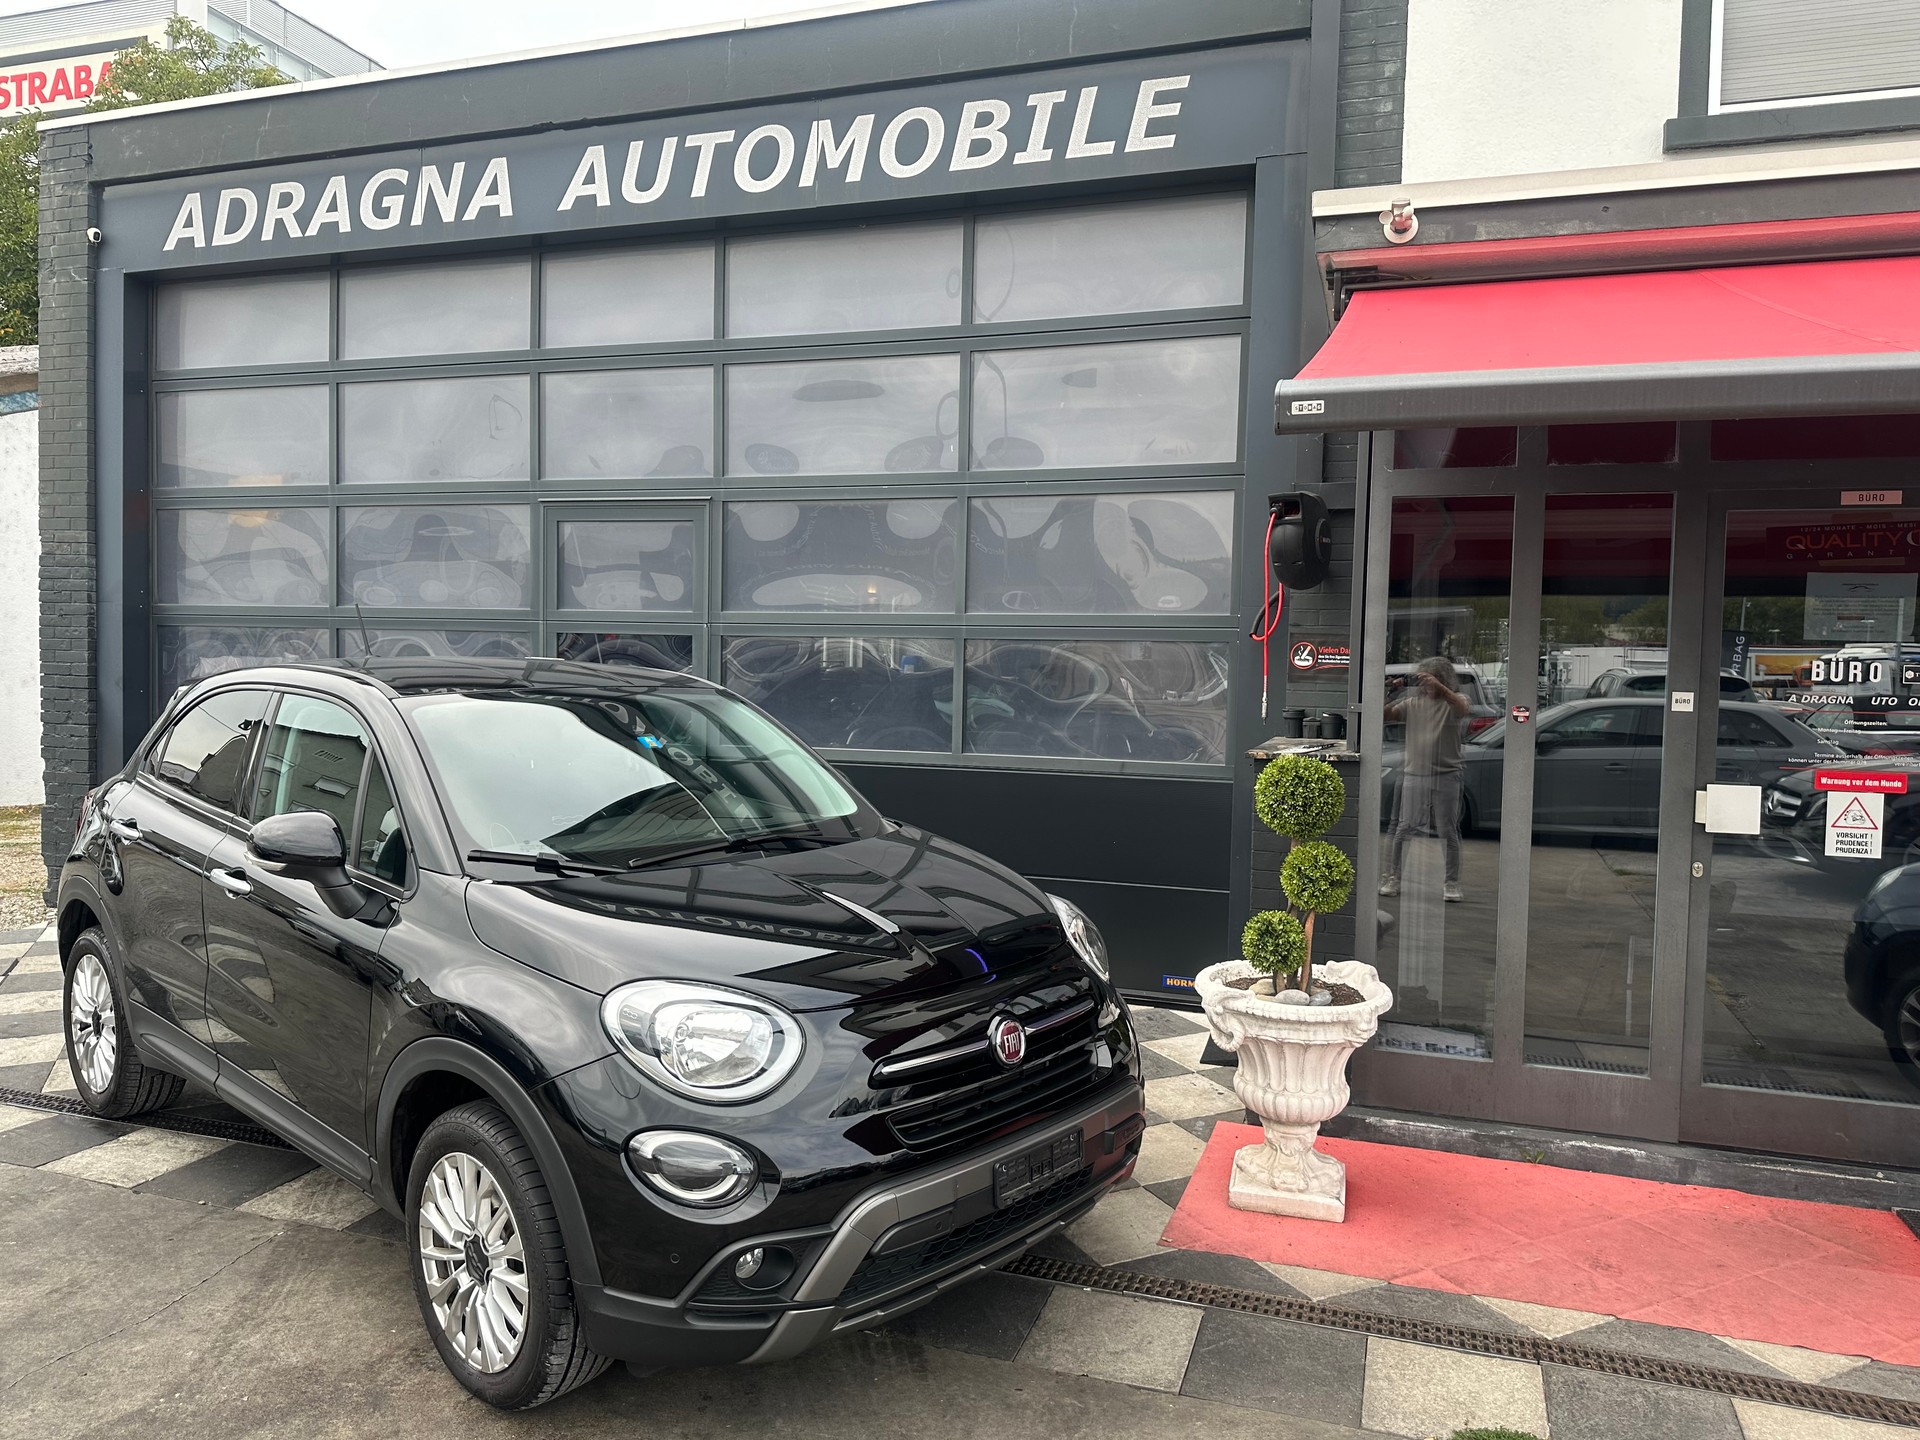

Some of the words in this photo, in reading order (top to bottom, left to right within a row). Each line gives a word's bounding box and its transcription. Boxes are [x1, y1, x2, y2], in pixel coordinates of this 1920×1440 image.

[163, 157, 514, 252] ADRAGNA
[557, 75, 1191, 211] AUTOMOBILE
[1858, 492, 1885, 501] BÜRO
[1785, 531, 1903, 550] QUALITY
[1318, 646, 1339, 654] Vielen
[1811, 657, 1883, 683] BÜRO
[1675, 697, 1690, 705] BÜRO
[1820, 777, 1850, 786] Warnung
[1836, 847, 1869, 855] PRUDENZA
[1003, 1031, 1021, 1055] FIAT
